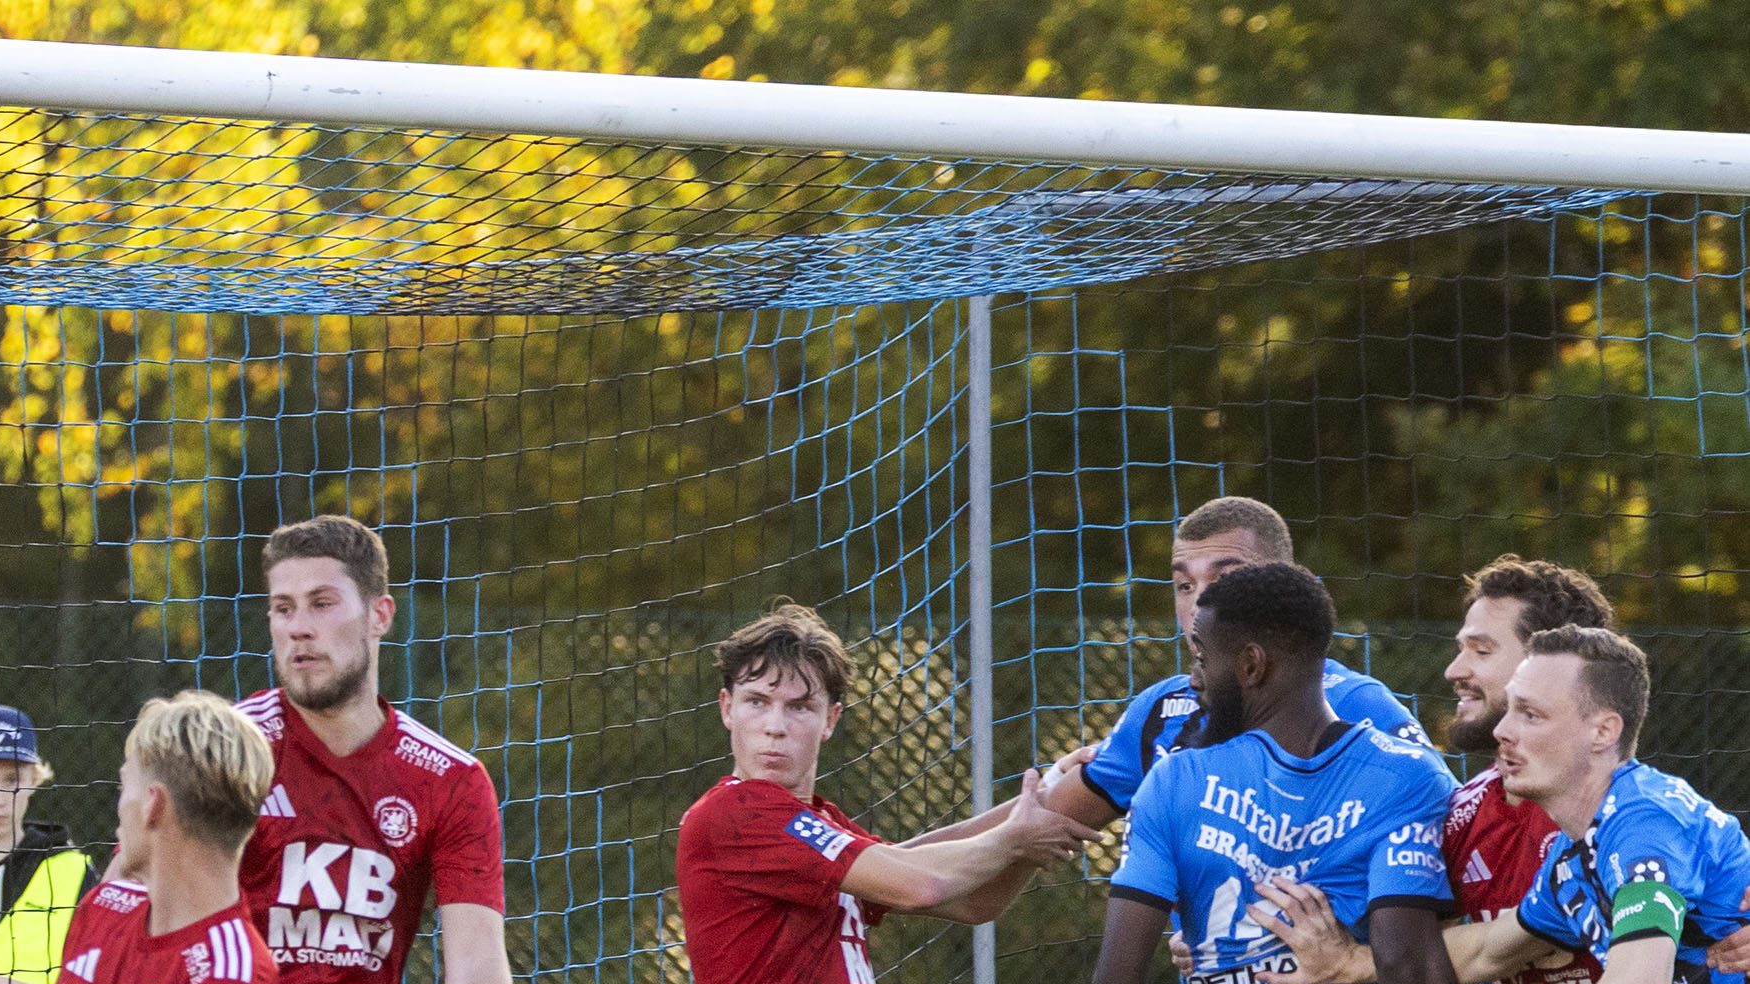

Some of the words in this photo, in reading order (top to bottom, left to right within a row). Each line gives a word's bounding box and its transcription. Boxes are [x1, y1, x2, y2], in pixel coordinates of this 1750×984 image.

[398, 735, 453, 770] GRAND
[1200, 775, 1366, 852] Infrakraft
[277, 840, 398, 920] KB
